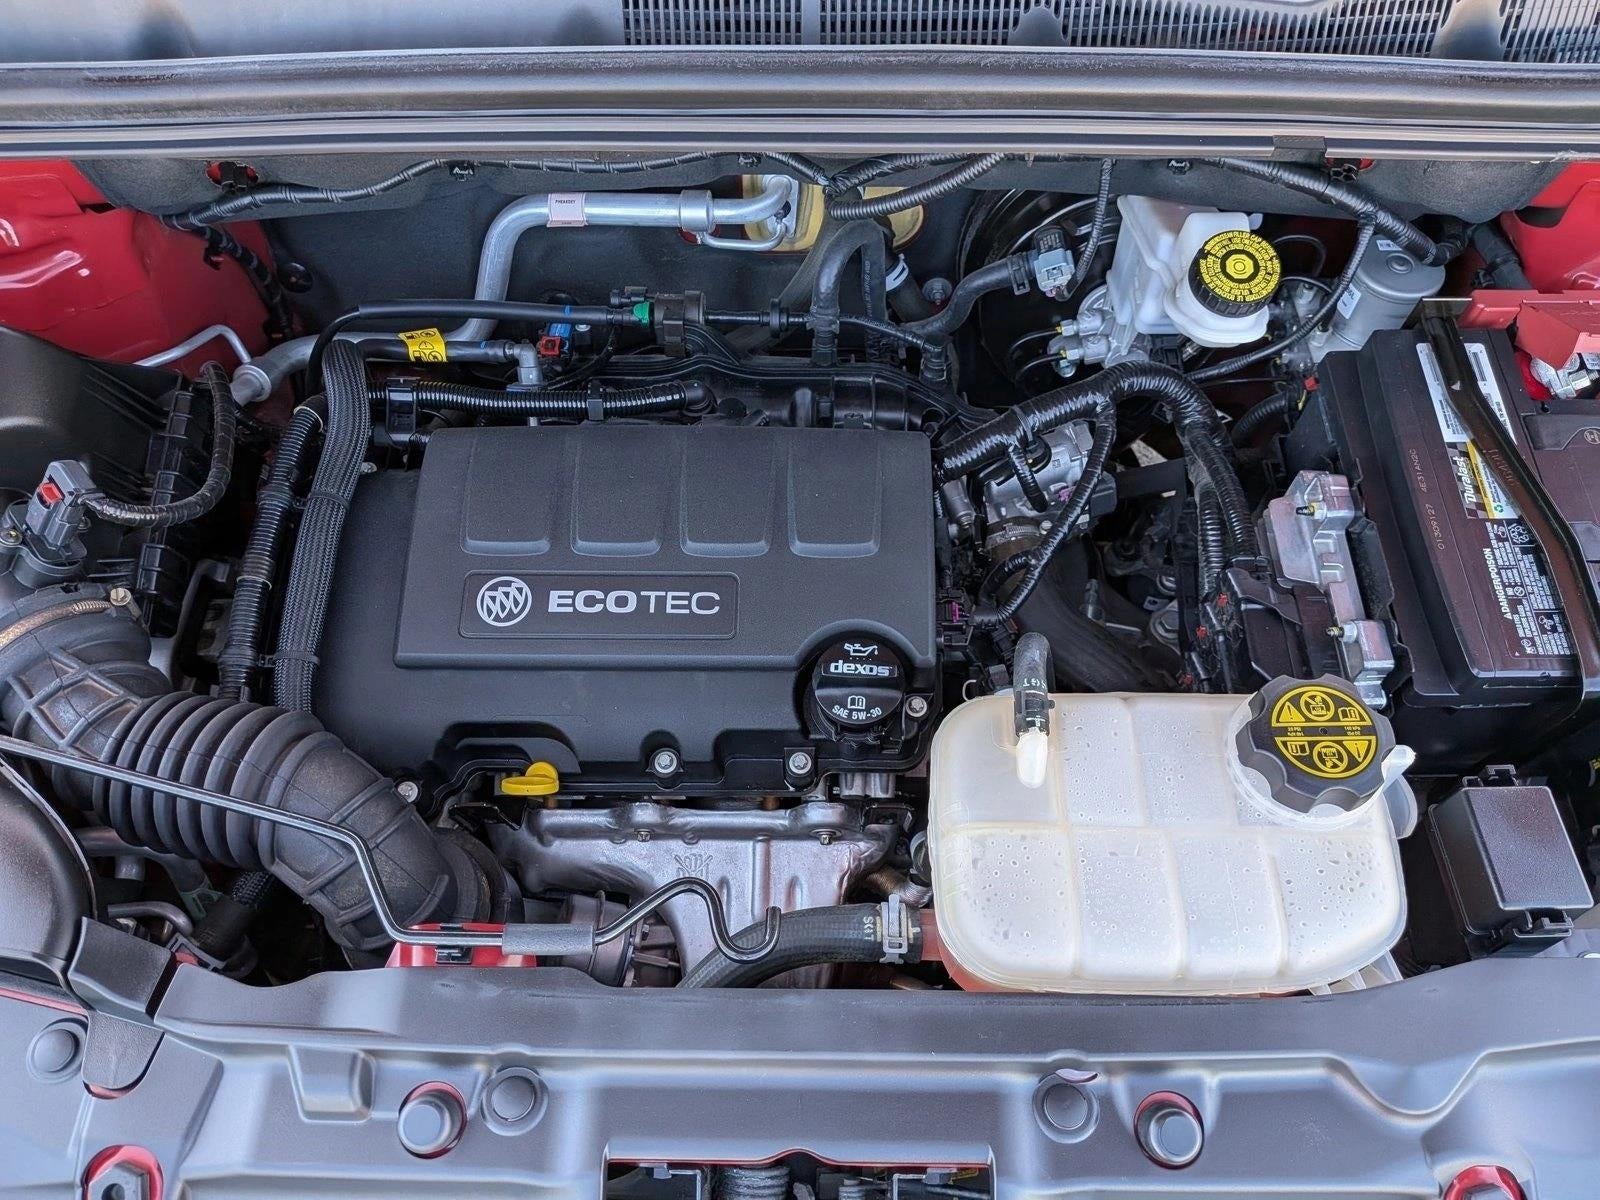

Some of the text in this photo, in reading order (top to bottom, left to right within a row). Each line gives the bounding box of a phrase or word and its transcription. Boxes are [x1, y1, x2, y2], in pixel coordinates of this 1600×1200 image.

[1453, 457, 1477, 503] Duralast
[1483, 548, 1510, 612] DANGER/POISON
[548, 590, 720, 614] ECOTEC
[832, 705, 882, 720] SAE 5W-30
